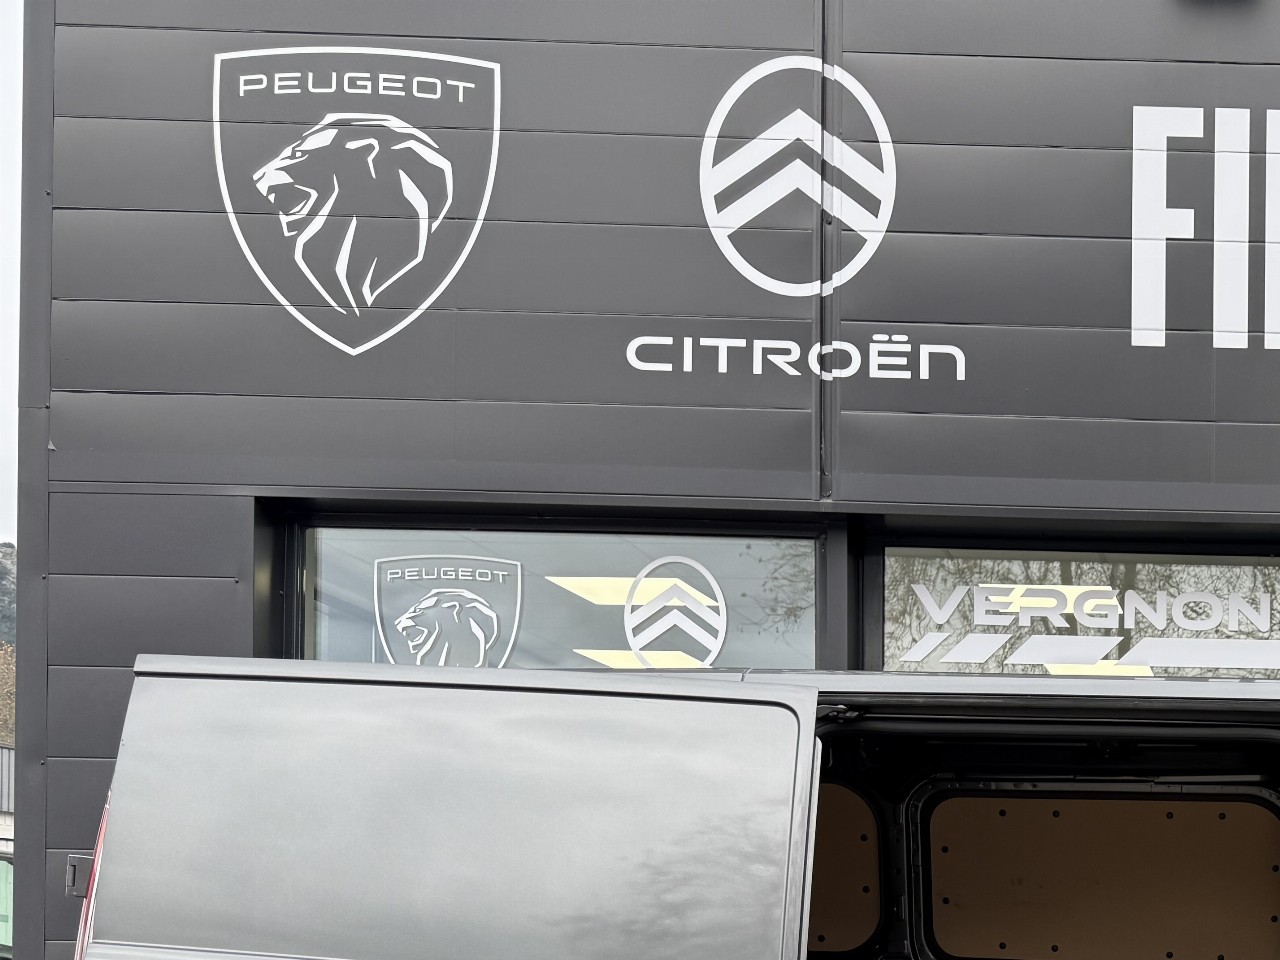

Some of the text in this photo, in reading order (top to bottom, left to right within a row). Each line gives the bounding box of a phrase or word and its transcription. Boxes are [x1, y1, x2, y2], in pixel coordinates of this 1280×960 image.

[239, 72, 476, 104] PEUGEOT
[387, 568, 509, 583] PEUGEOT
[911, 583, 1271, 633] VERGNON
